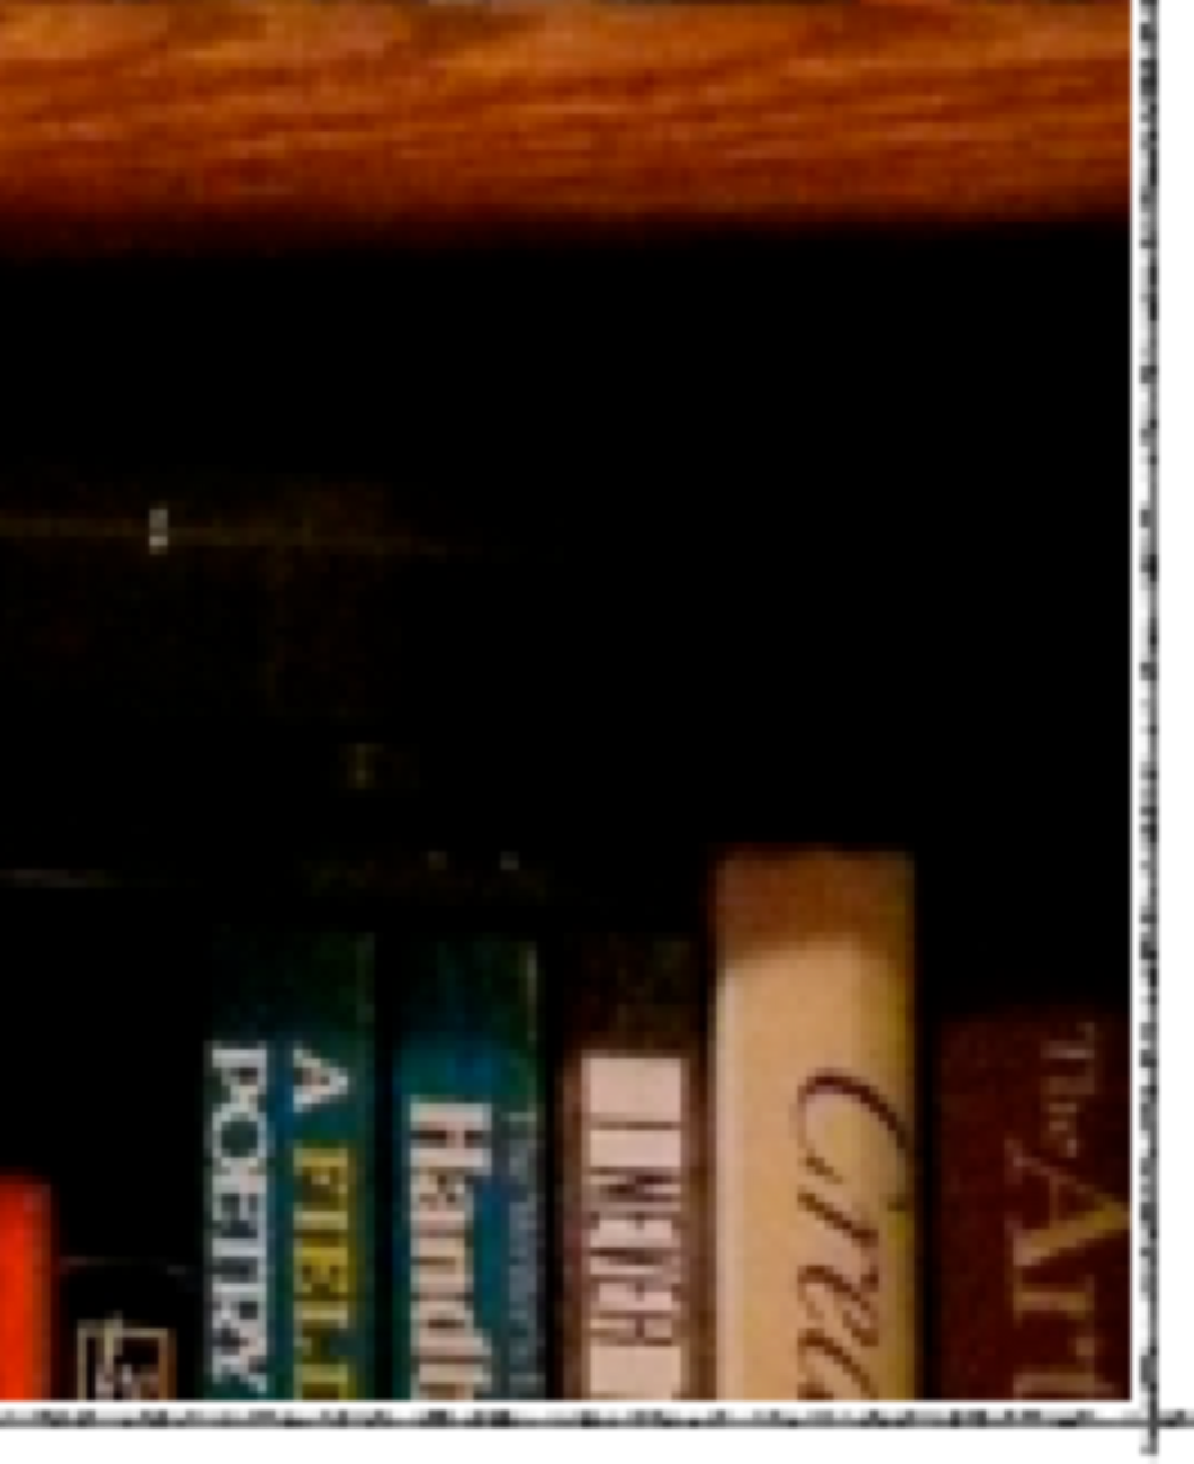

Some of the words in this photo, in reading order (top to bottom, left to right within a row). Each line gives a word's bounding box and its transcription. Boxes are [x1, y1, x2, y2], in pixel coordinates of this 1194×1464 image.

[290, 1040, 354, 1115] A
[1039, 1017, 1099, 1159] The
[207, 1040, 274, 1397] POETRY
